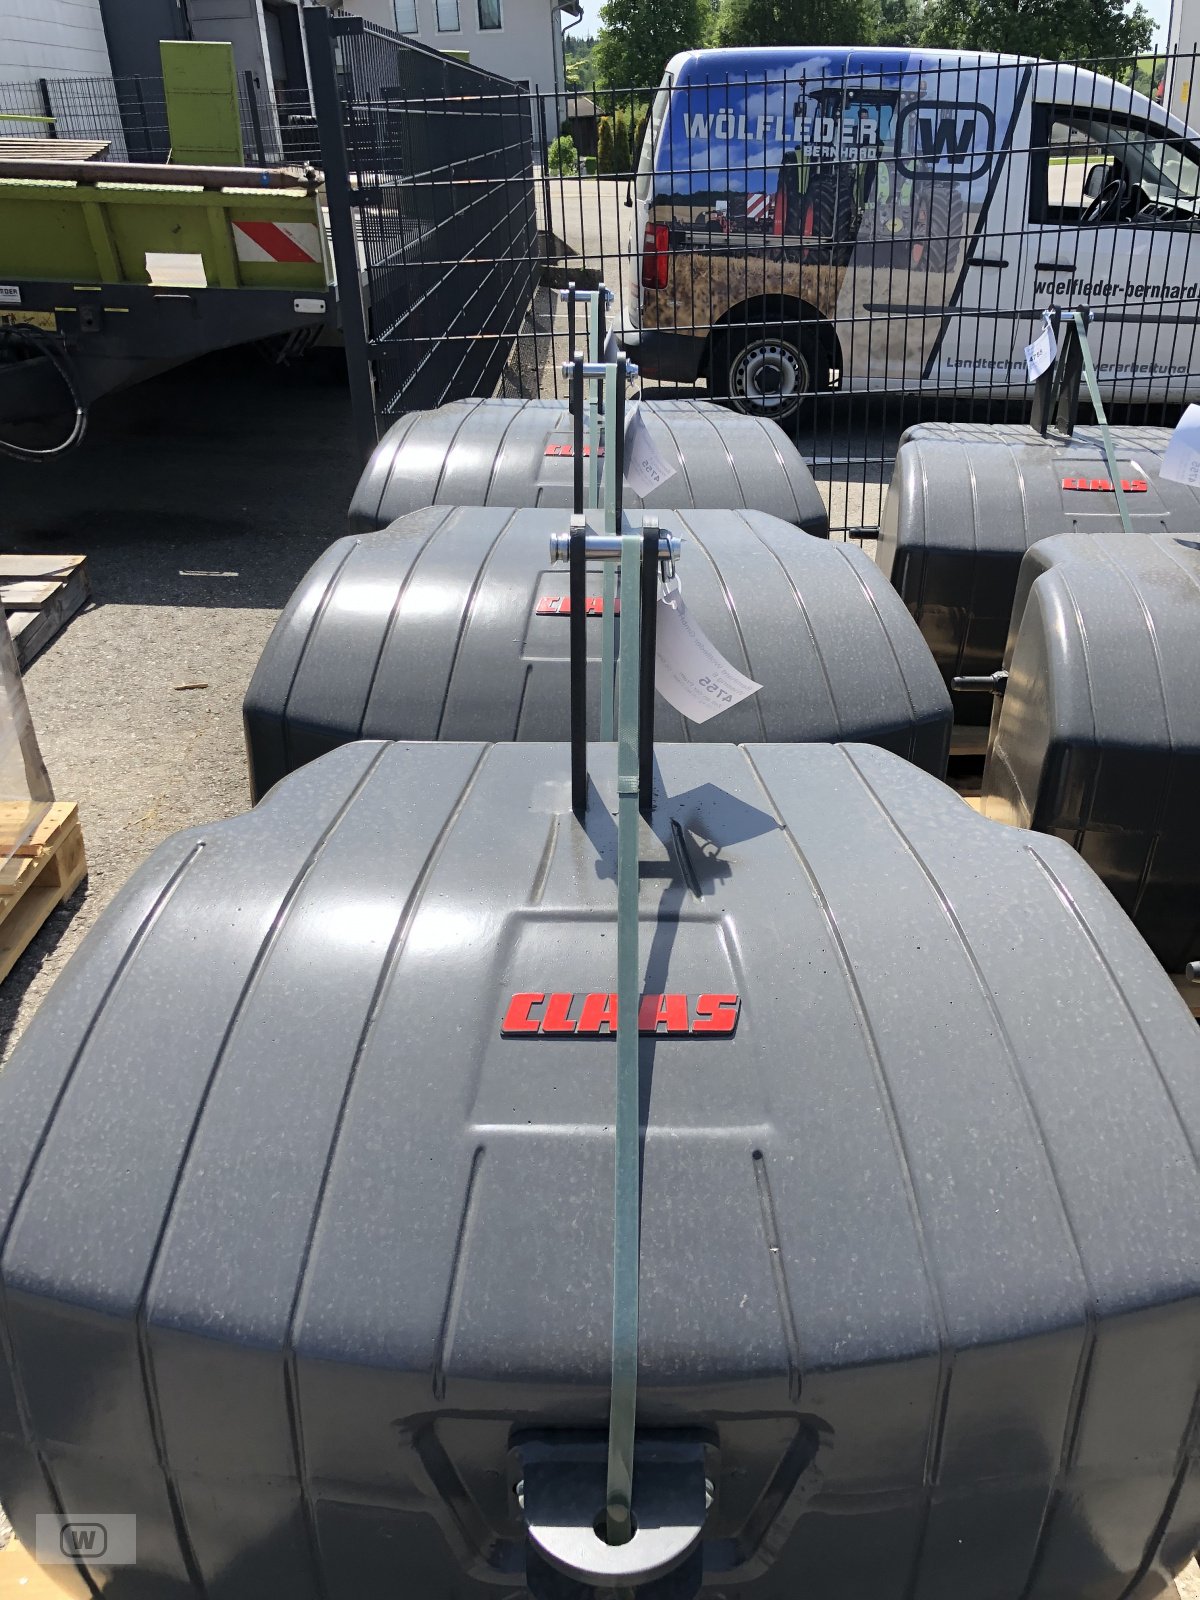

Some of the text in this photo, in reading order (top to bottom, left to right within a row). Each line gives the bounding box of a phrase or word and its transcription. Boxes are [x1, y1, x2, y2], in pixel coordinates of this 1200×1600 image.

[684, 108, 877, 144] WÖLFLEDER
[919, 118, 974, 164] W
[803, 145, 876, 157] BERNHARD
[946, 357, 1029, 370] Landtechni
[501, 992, 741, 1037] CLAAS
